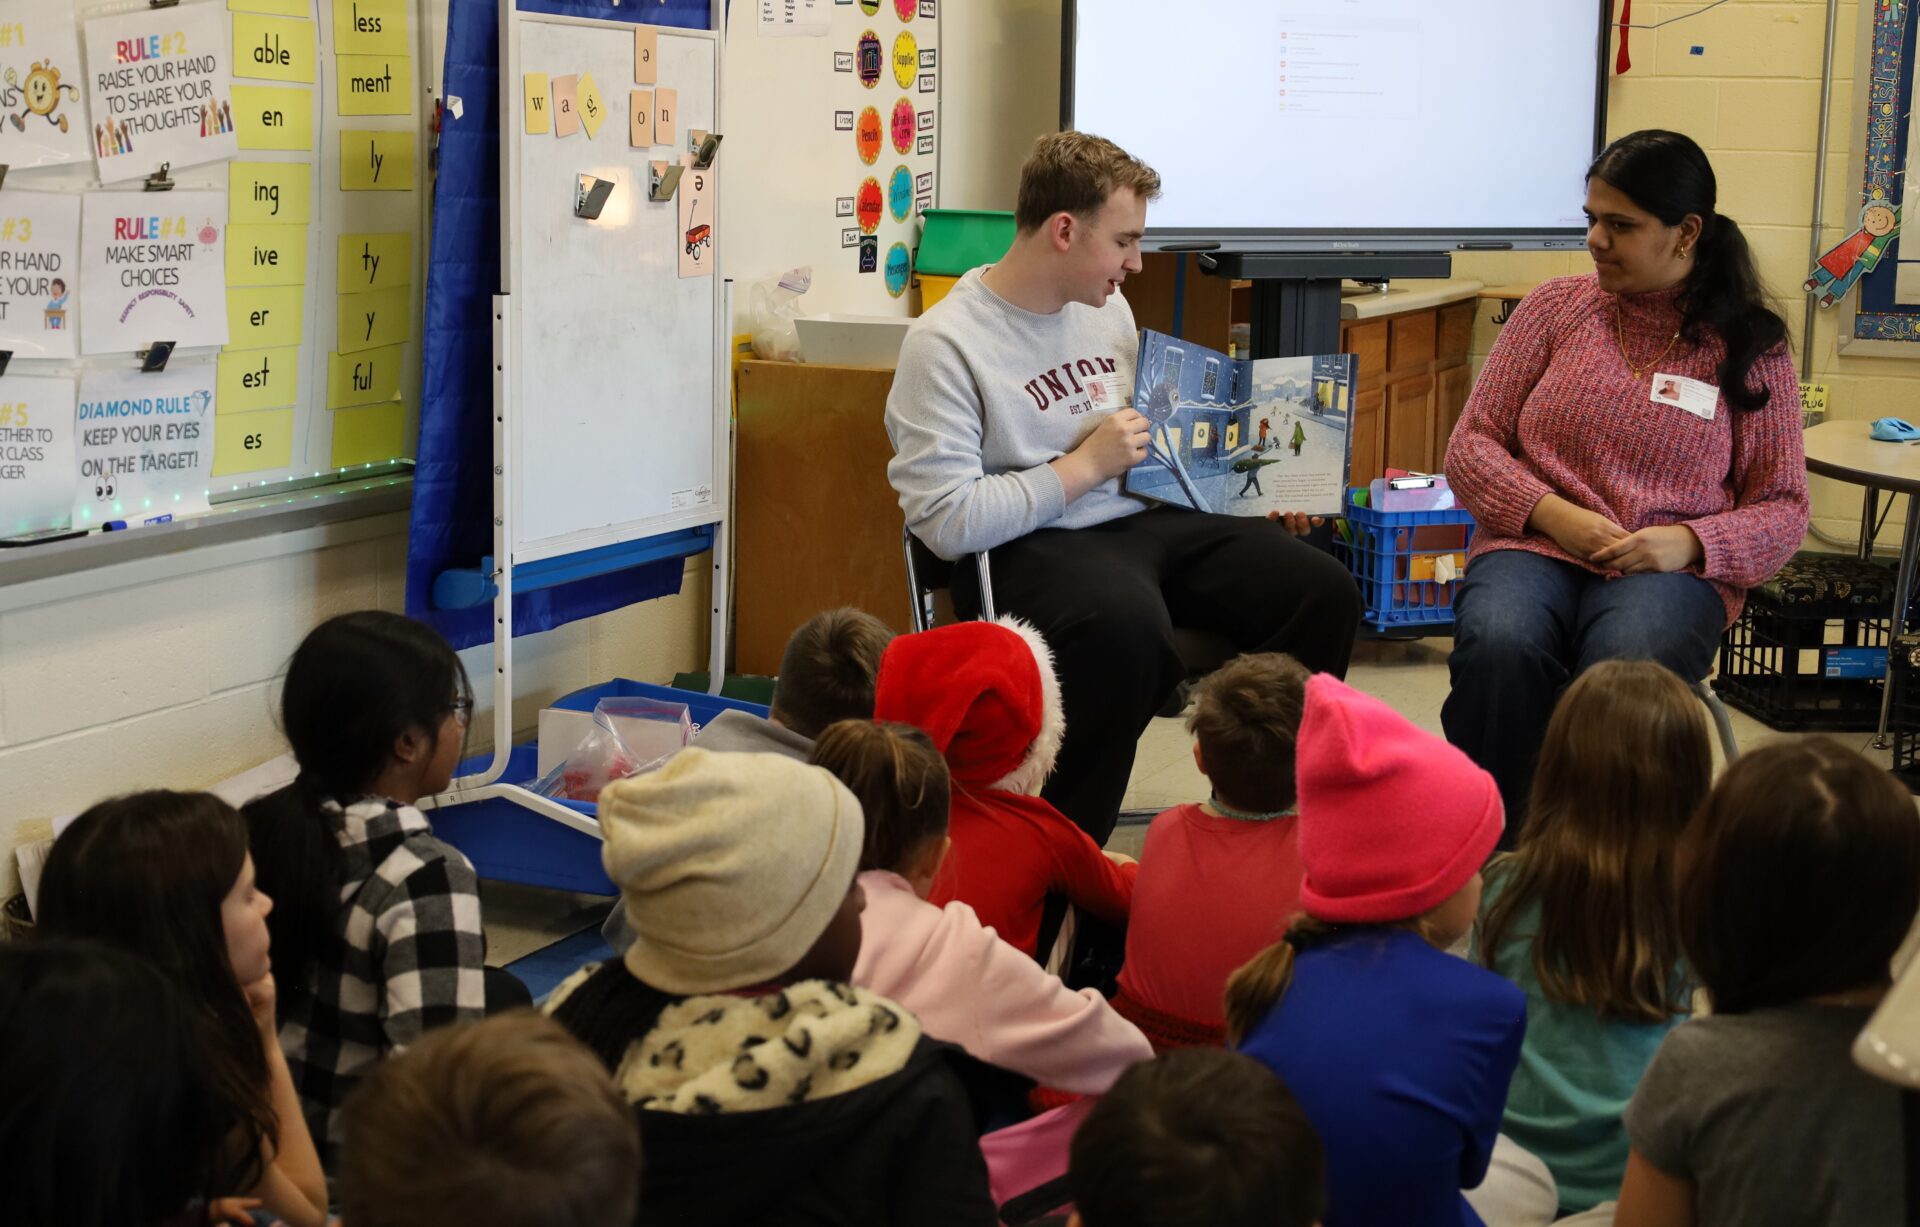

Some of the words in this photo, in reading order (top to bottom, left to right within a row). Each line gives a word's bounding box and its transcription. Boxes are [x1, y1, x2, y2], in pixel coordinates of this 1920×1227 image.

[353, 2, 382, 33] less
[254, 33, 290, 65] able
[98, 68, 135, 92] RAISE
[136, 62, 175, 84] YOUR
[177, 55, 216, 77] HAND
[352, 63, 391, 93] ment
[106, 95, 126, 114] TO
[128, 86, 174, 111] SHARE
[175, 79, 213, 101] YOUR
[125, 106, 200, 135] THOUGHTS
[262, 110, 283, 126] en
[371, 139, 383, 183] ly
[254, 181, 279, 215] ing
[15, 252, 61, 272] HAND
[106, 245, 145, 264] MAKE
[148, 244, 194, 262] SMART
[253, 246, 278, 265] ive
[362, 242, 380, 284] ty
[6, 277, 49, 296] YOUR
[121, 267, 179, 287] CHOICES
[250, 310, 269, 326] er
[366, 311, 375, 341] y
[242, 357, 269, 388] est
[353, 361, 372, 391] ful
[1024, 357, 1116, 411] UNION
[80, 399, 152, 420] DIAMOND
[156, 396, 190, 414] RULE
[35, 428, 53, 443] TO
[83, 427, 118, 447] KEEP
[122, 424, 162, 443] YOUR
[166, 422, 200, 440] EYES
[244, 433, 262, 450] es
[6, 446, 44, 461] CLASS
[81, 458, 103, 477] ON
[108, 456, 136, 474] THE
[140, 451, 198, 471] TARGET!
